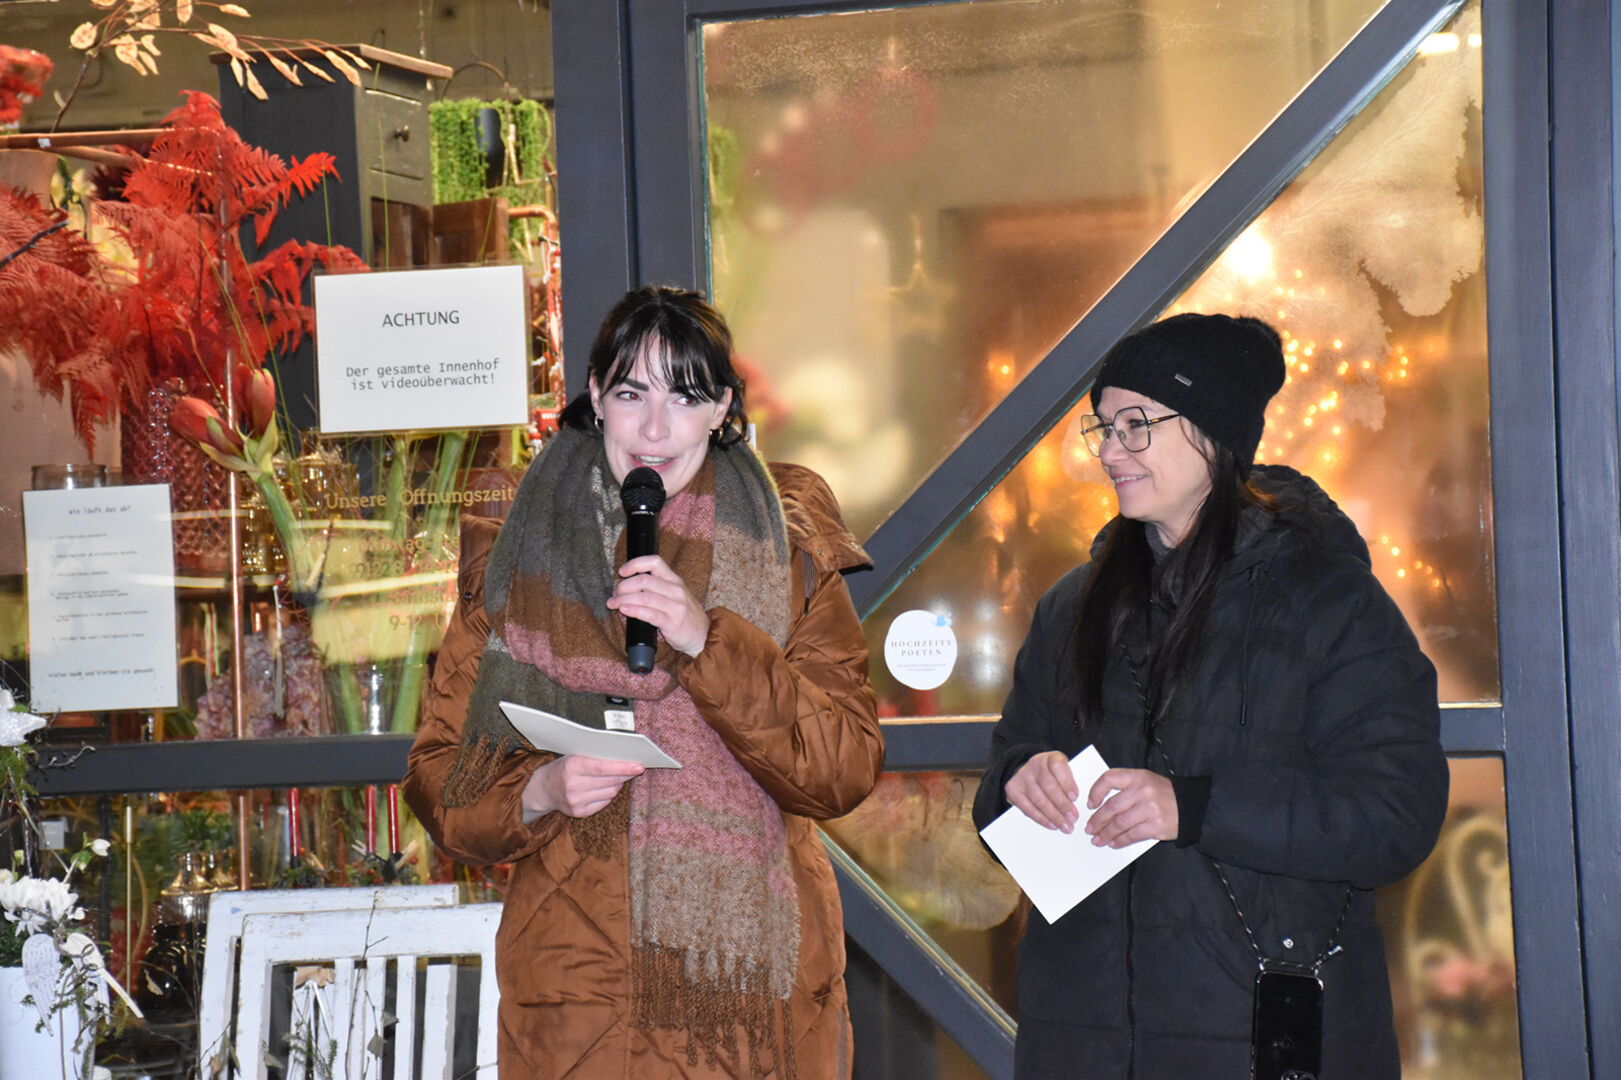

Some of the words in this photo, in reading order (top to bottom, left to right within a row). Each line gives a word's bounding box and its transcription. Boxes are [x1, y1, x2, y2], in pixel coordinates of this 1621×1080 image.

[382, 310, 460, 327] ACHTUNG
[346, 366, 369, 377] Der
[377, 364, 431, 379] gesamte
[439, 357, 500, 373] Innenhof
[351, 378, 374, 390] ist
[381, 372, 494, 389] videoüberwacht!
[326, 493, 387, 509] Unsere
[400, 485, 516, 506] Öffnungszeit
[890, 640, 952, 648] HOCHZEITS
[901, 649, 942, 657] POETEN
